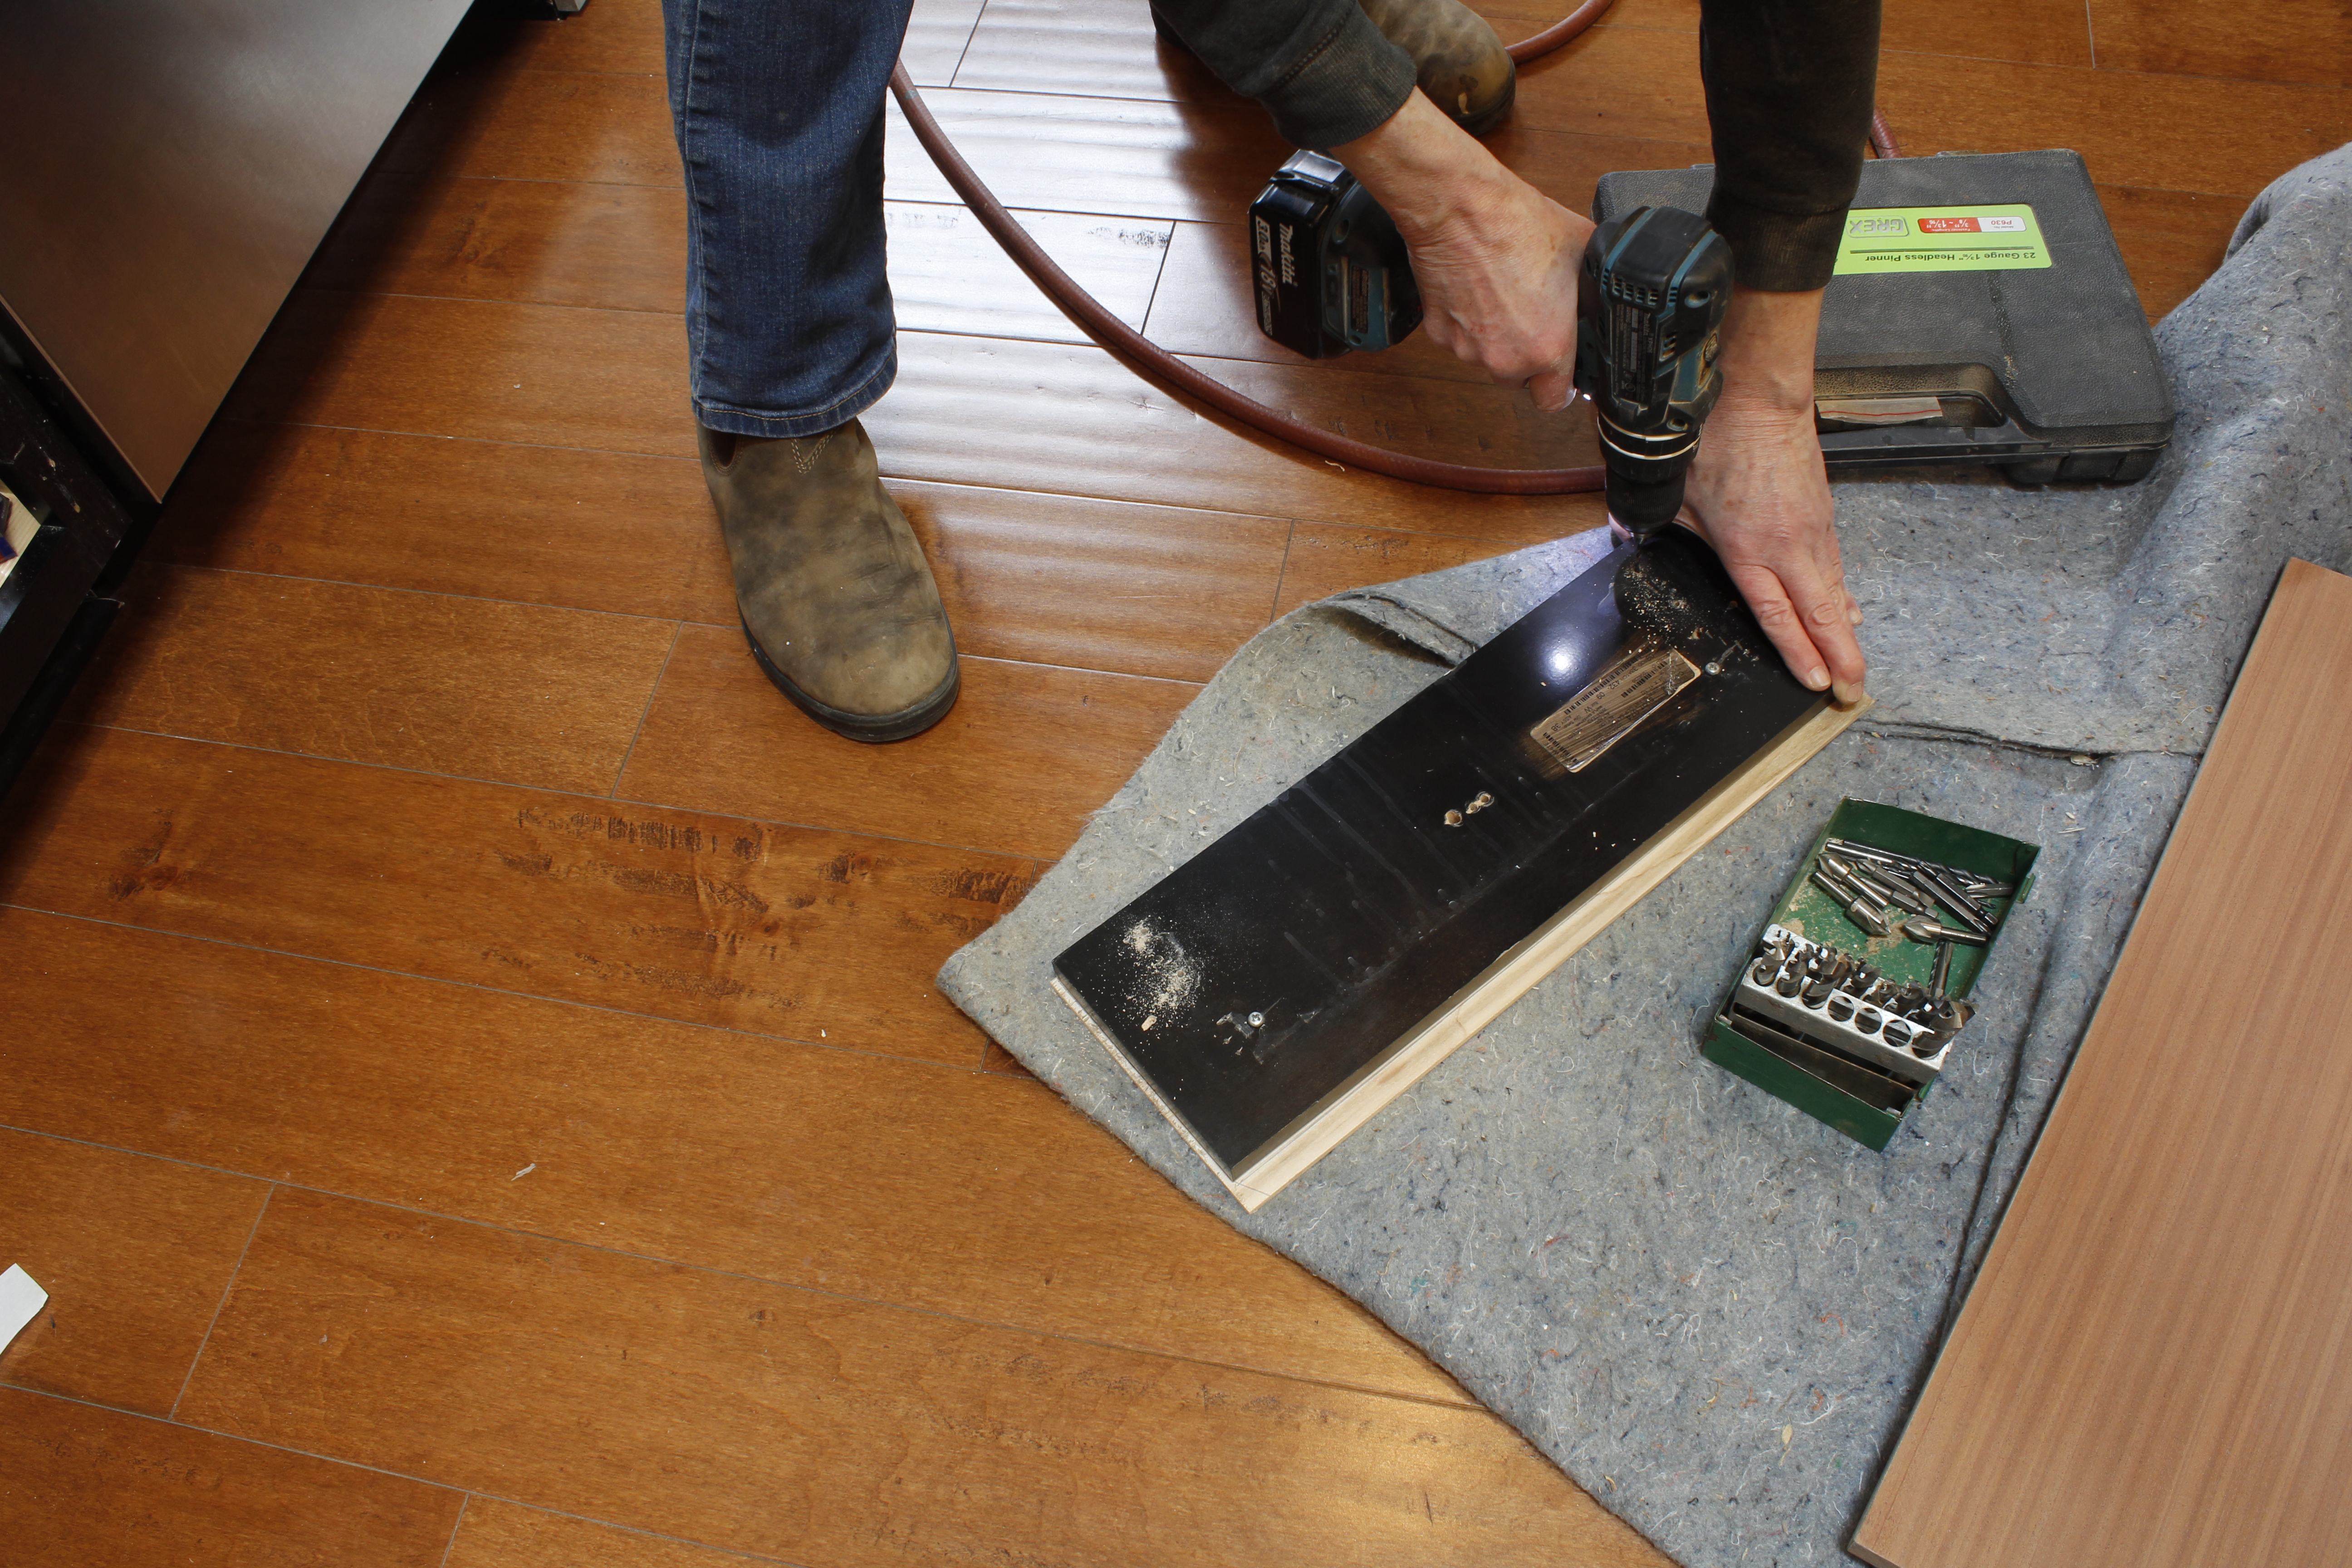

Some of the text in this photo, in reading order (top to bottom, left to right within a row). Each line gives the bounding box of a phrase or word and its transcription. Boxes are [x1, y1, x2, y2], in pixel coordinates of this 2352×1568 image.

[1850, 220, 1904, 233] GREX
[1594, 691, 1605, 700] 09
[1550, 722, 1562, 732] 3B
